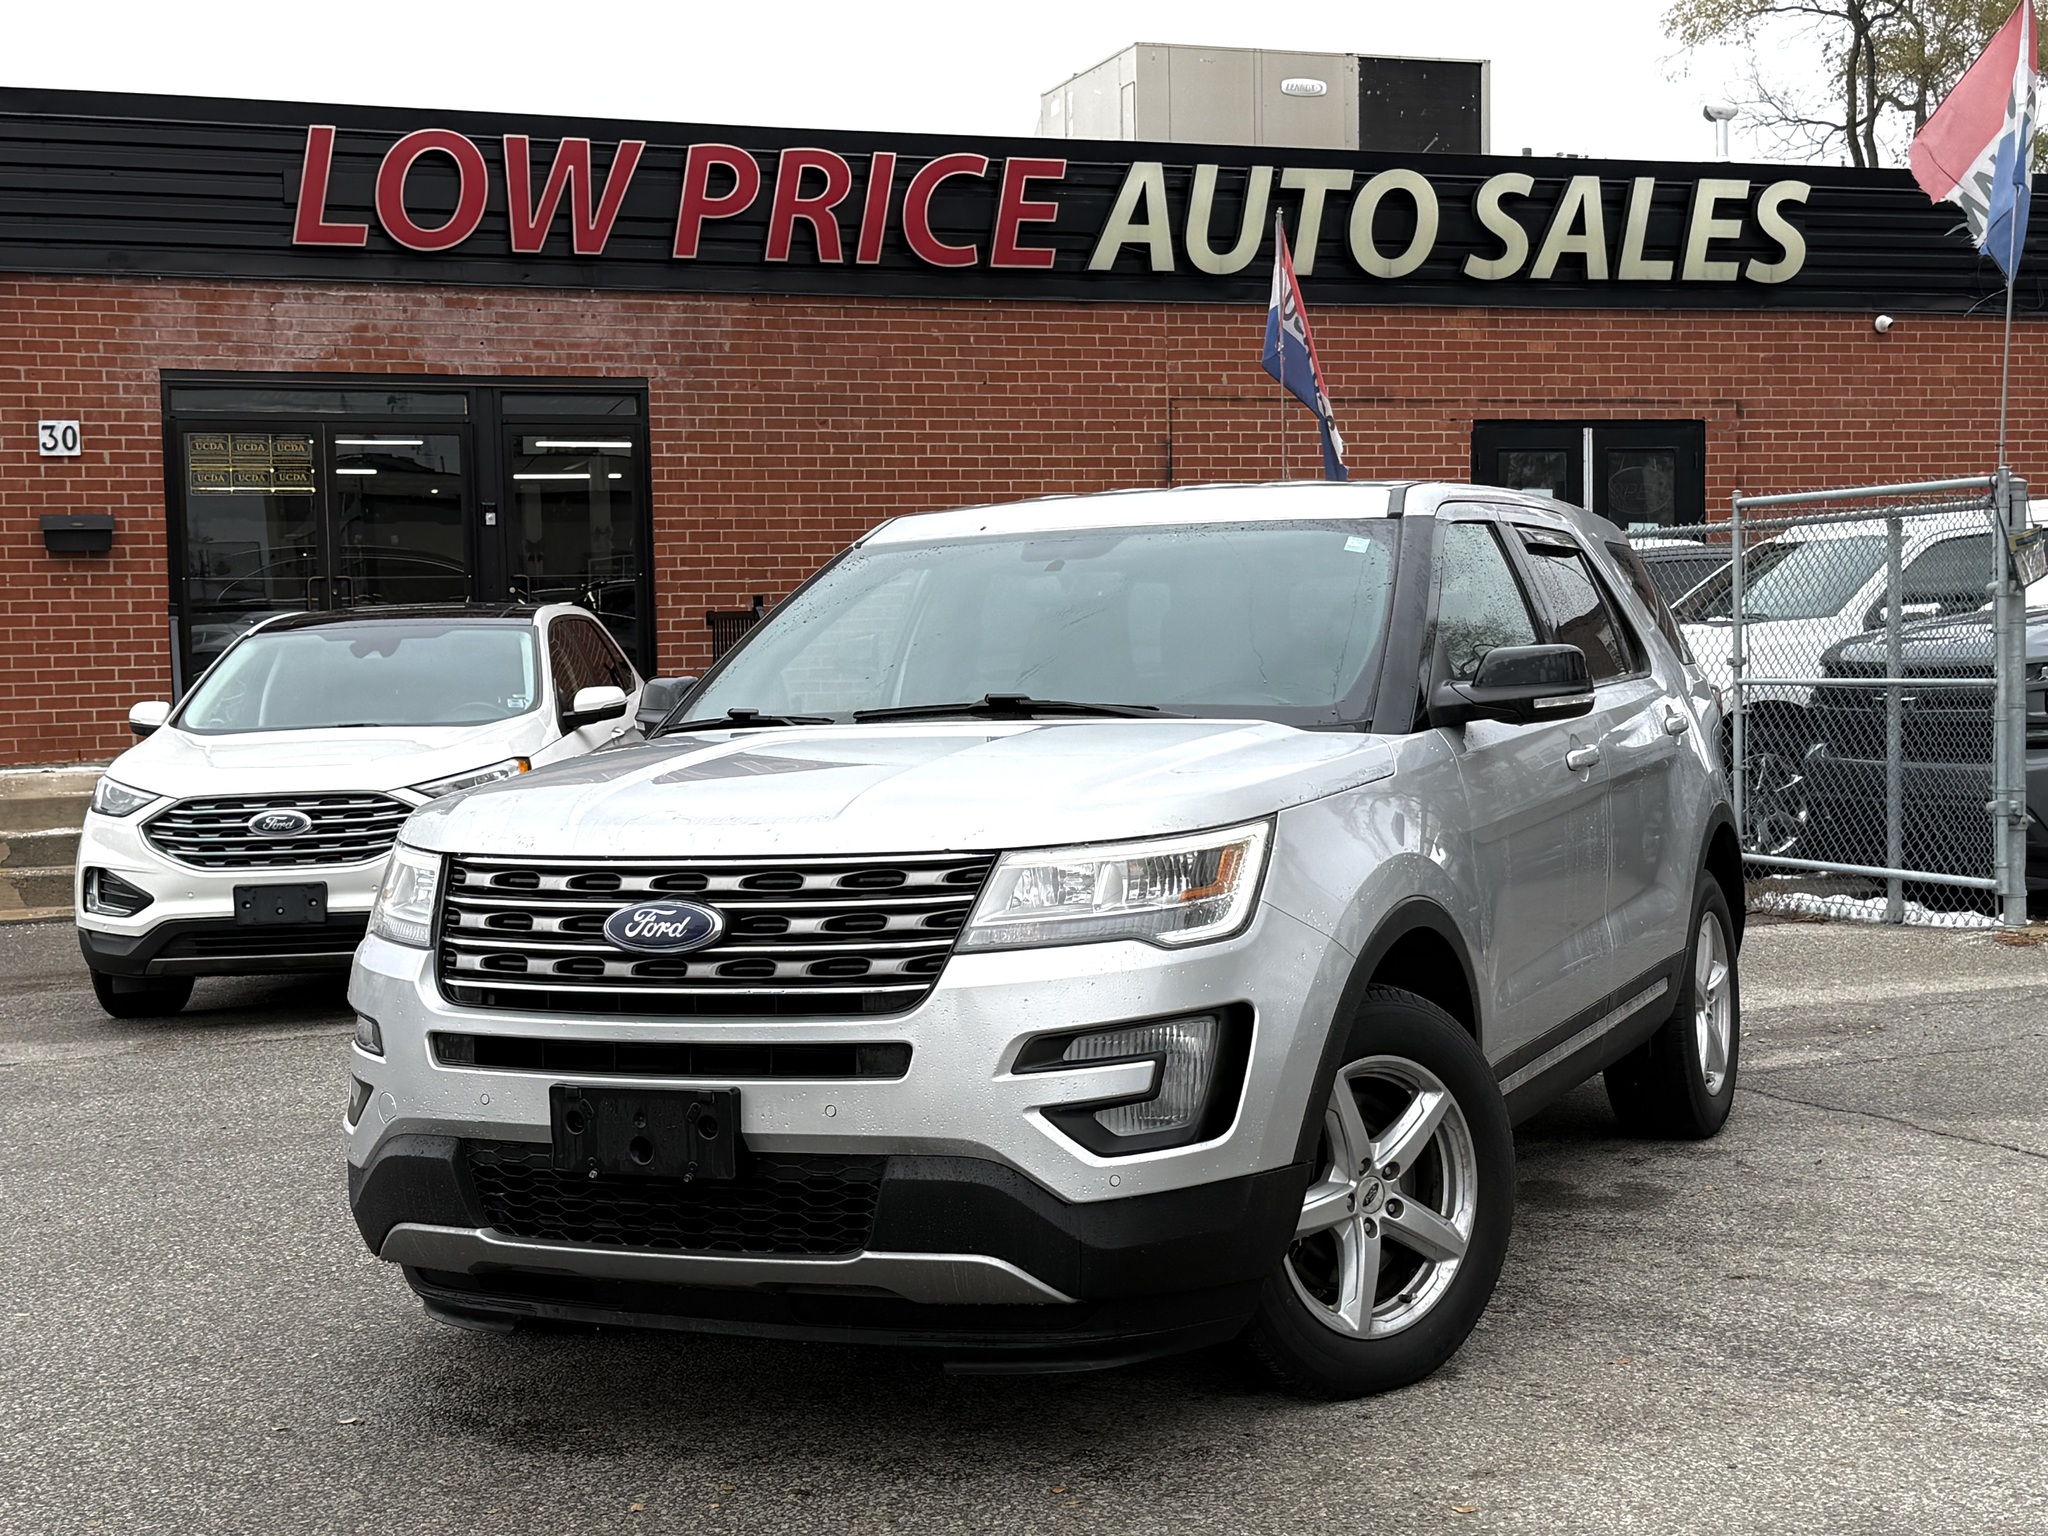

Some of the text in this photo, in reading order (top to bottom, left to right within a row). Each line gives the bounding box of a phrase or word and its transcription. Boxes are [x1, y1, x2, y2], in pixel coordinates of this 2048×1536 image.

[292, 124, 1812, 284] LOW PRICE AUTO SALES
[41, 425, 78, 451] 30
[195, 442, 225, 450] UCDA
[236, 443, 266, 452] UCDA
[277, 443, 306, 452] UCDA
[197, 474, 225, 482] UCDA
[238, 474, 266, 482] UCDA
[279, 473, 308, 481] UCDA
[262, 816, 296, 830] Ford
[624, 908, 692, 938] Ford
